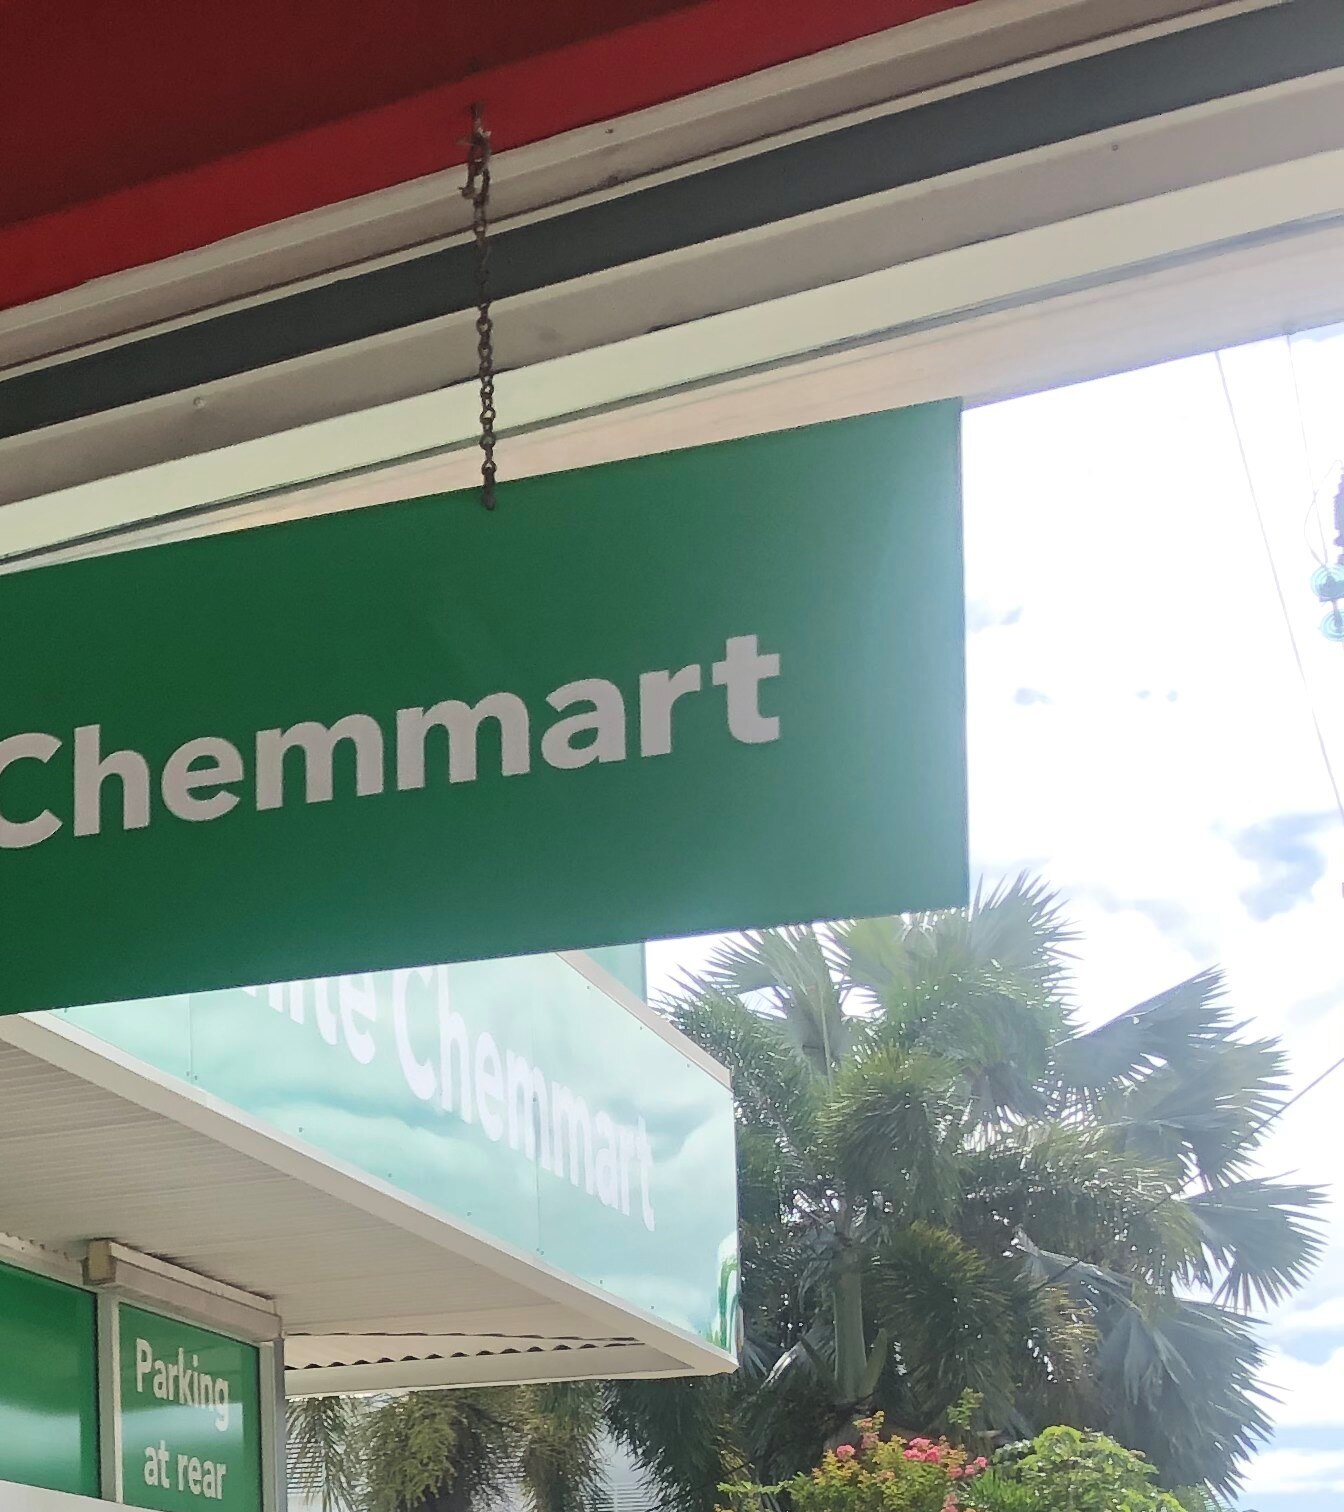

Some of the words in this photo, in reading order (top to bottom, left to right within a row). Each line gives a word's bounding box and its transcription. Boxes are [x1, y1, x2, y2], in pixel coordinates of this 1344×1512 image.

[392, 964, 655, 1231] Chemmart
[134, 1337, 230, 1433] Parking
[143, 1444, 169, 1488] at
[176, 1451, 226, 1502] rear
